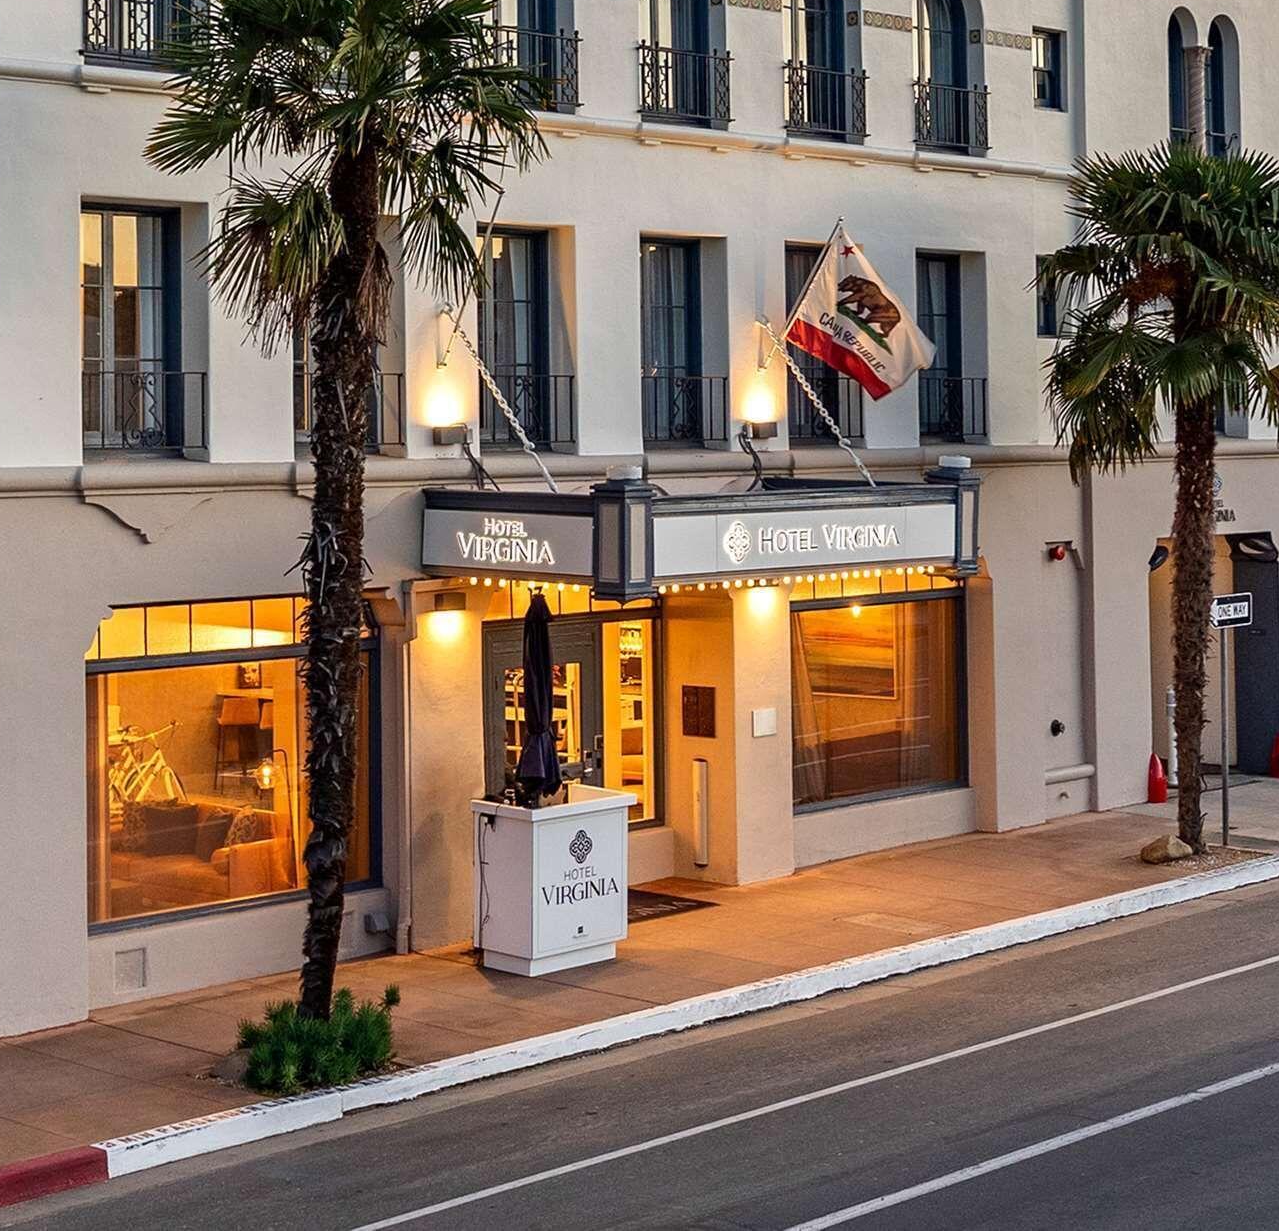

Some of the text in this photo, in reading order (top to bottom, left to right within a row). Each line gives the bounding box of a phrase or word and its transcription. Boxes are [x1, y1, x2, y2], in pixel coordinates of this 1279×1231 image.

[483, 517, 528, 537] HOTEL
[758, 523, 901, 554] HOTEL VIRGINIA
[456, 531, 556, 565] VIRGINIA
[1217, 603, 1247, 618] ONE WAY
[563, 866, 597, 881] HOTEL
[541, 877, 619, 905] VIRGINIA
